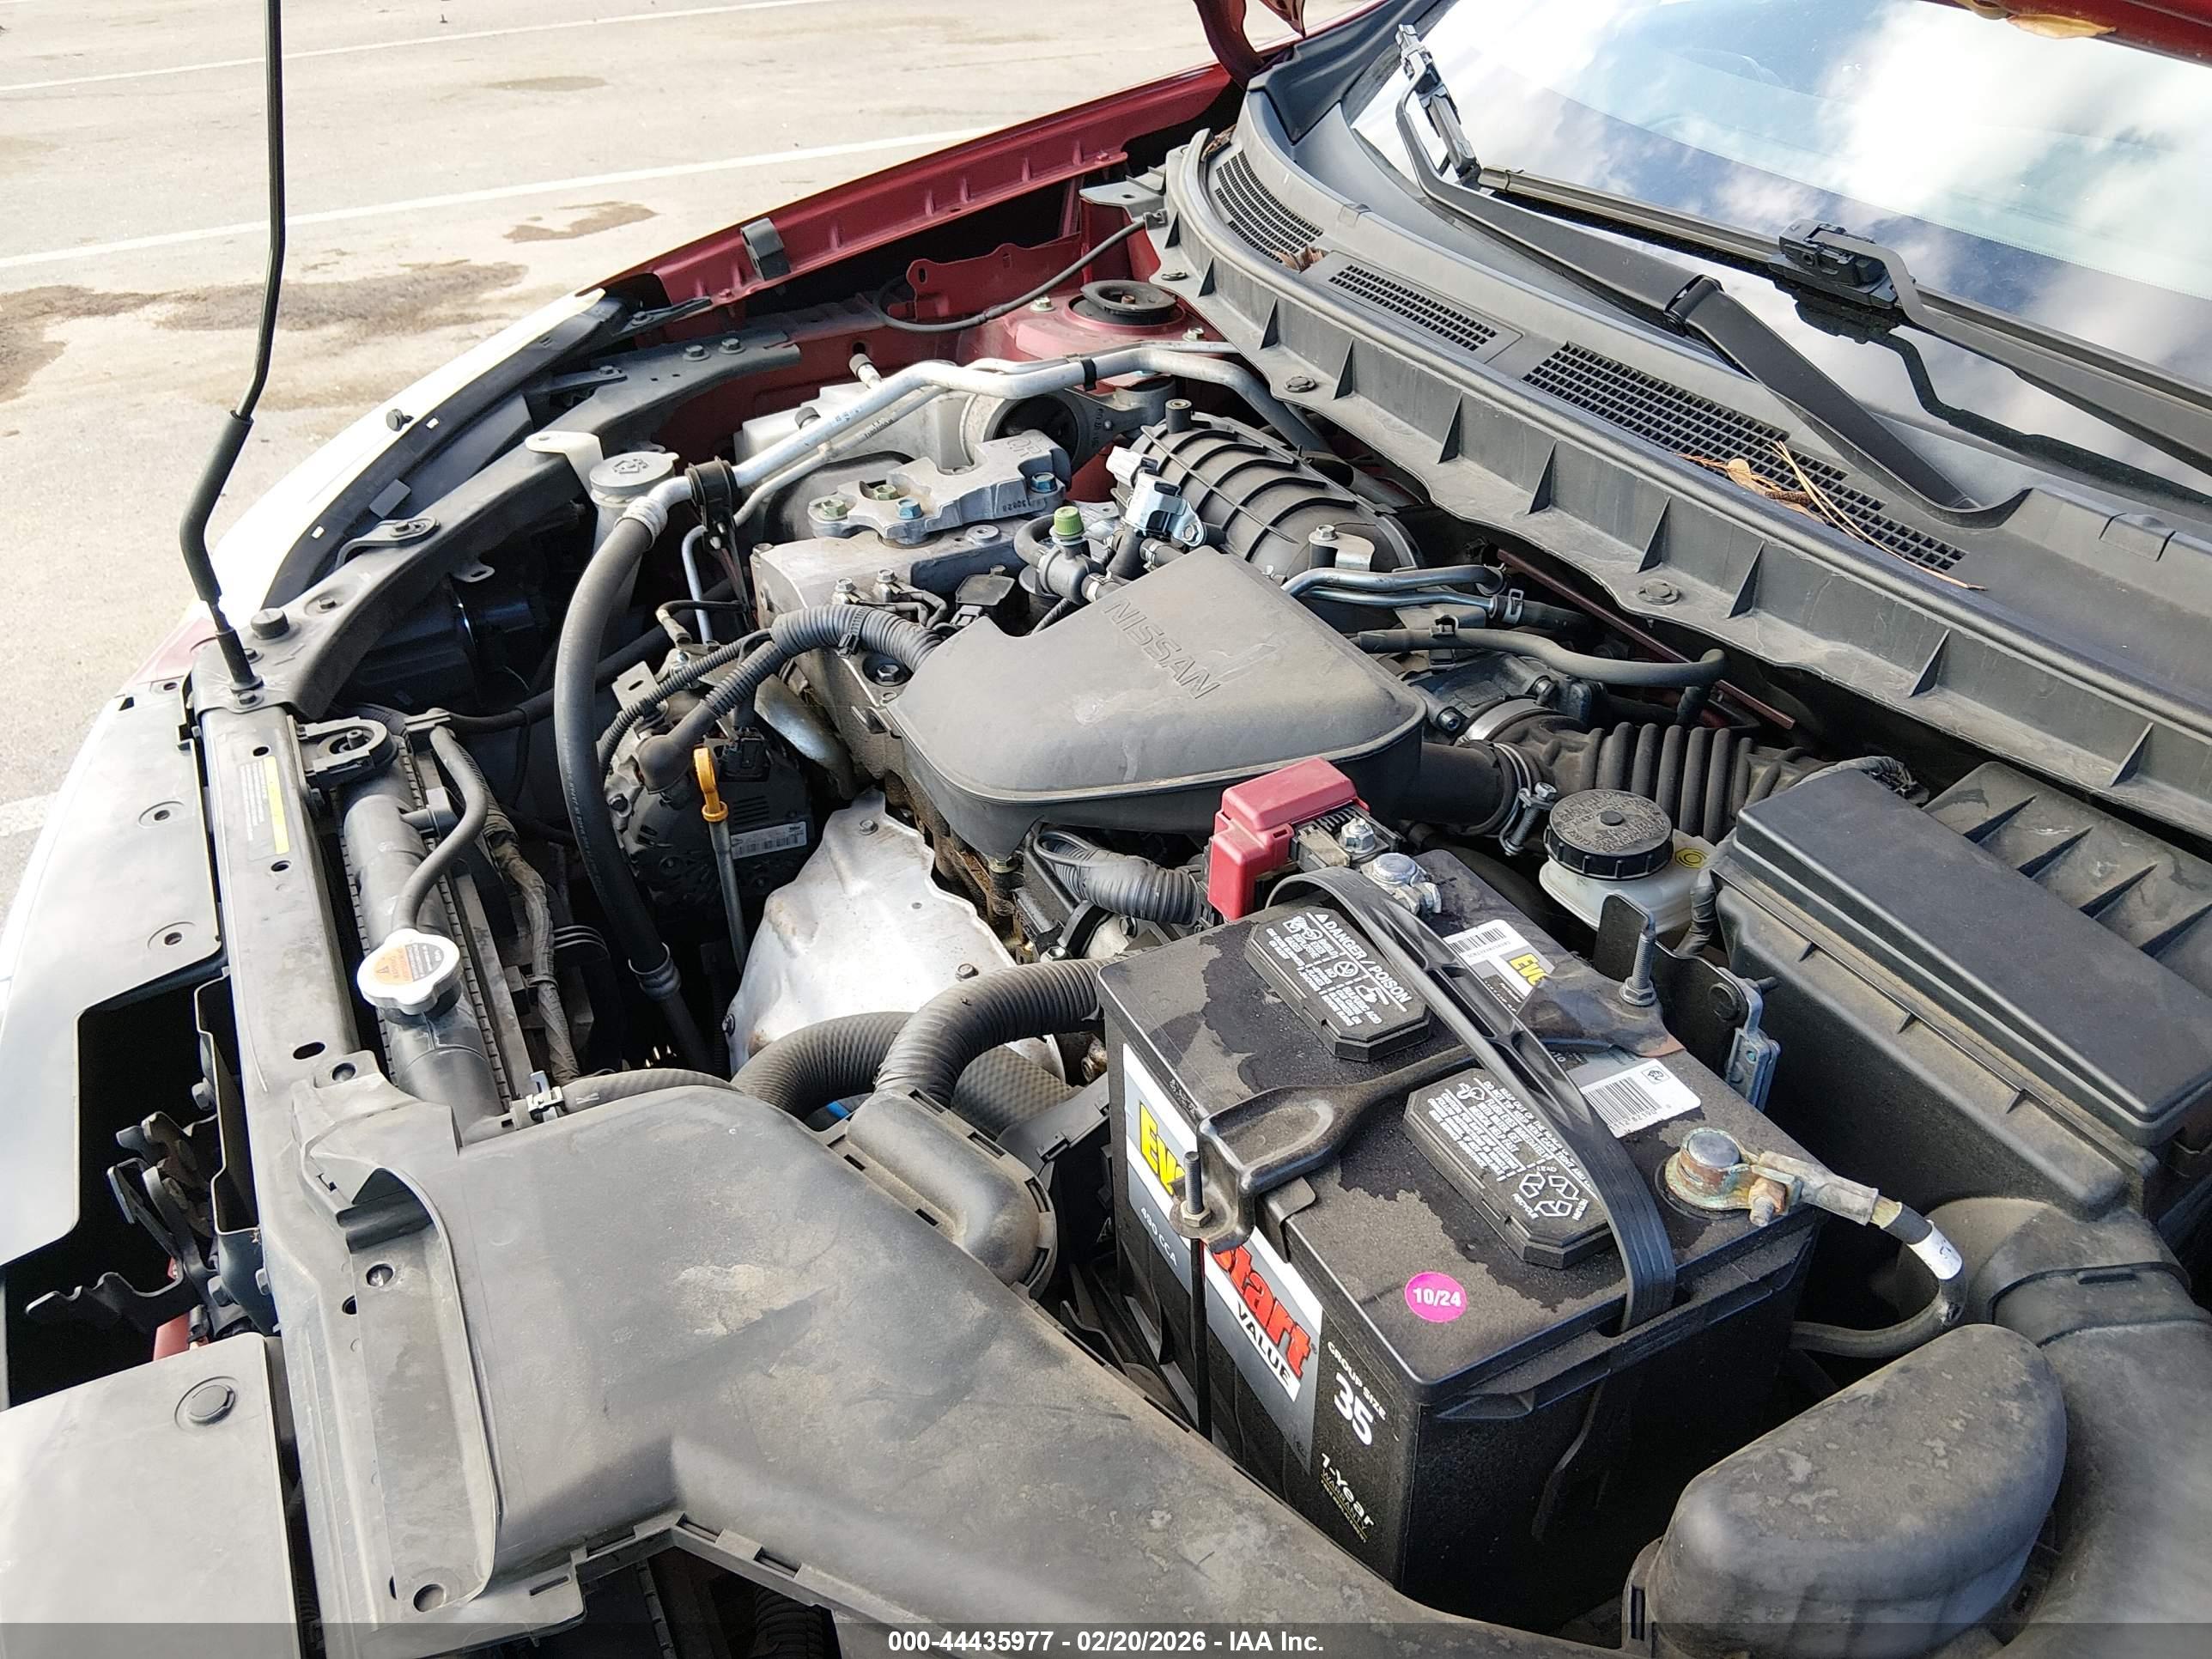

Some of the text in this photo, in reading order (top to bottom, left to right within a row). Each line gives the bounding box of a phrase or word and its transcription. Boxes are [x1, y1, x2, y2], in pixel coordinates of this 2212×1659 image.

[1103, 599, 1221, 700] NISSAN
[1291, 933, 1321, 959] EXPLOSIVE
[1324, 921, 1367, 960] DANGER
[1369, 965, 1412, 1003] POISON
[1468, 1106, 1520, 1152] MEDICAL HELP FAST
[1483, 1081, 1495, 1091] DO
[1492, 1089, 1506, 1101] NOT
[1513, 1110, 1530, 1124] KEEP
[1527, 1123, 1544, 1138] VENT
[1540, 1137, 1559, 1152] CAPS
[1556, 1152, 1575, 1168] TIGHT
[1485, 1098, 1505, 1116] FLUSH
[1500, 1114, 1518, 1128] EYES
[1507, 1132, 1523, 1144] GET
[1513, 1101, 1528, 1113] OUT
[1141, 1206, 1176, 1267] 490 CCA
[1512, 1193, 1539, 1219] RECYCLE
[1413, 1287, 1462, 1308] 10/24
[1237, 1300, 1292, 1387] VALUE
[1328, 1341, 1387, 1421] GROUP SIZE
[1334, 1371, 1374, 1446] 35
[1322, 1452, 1375, 1527] 1-Year
[1322, 1468, 1368, 1531] WARRANTY
